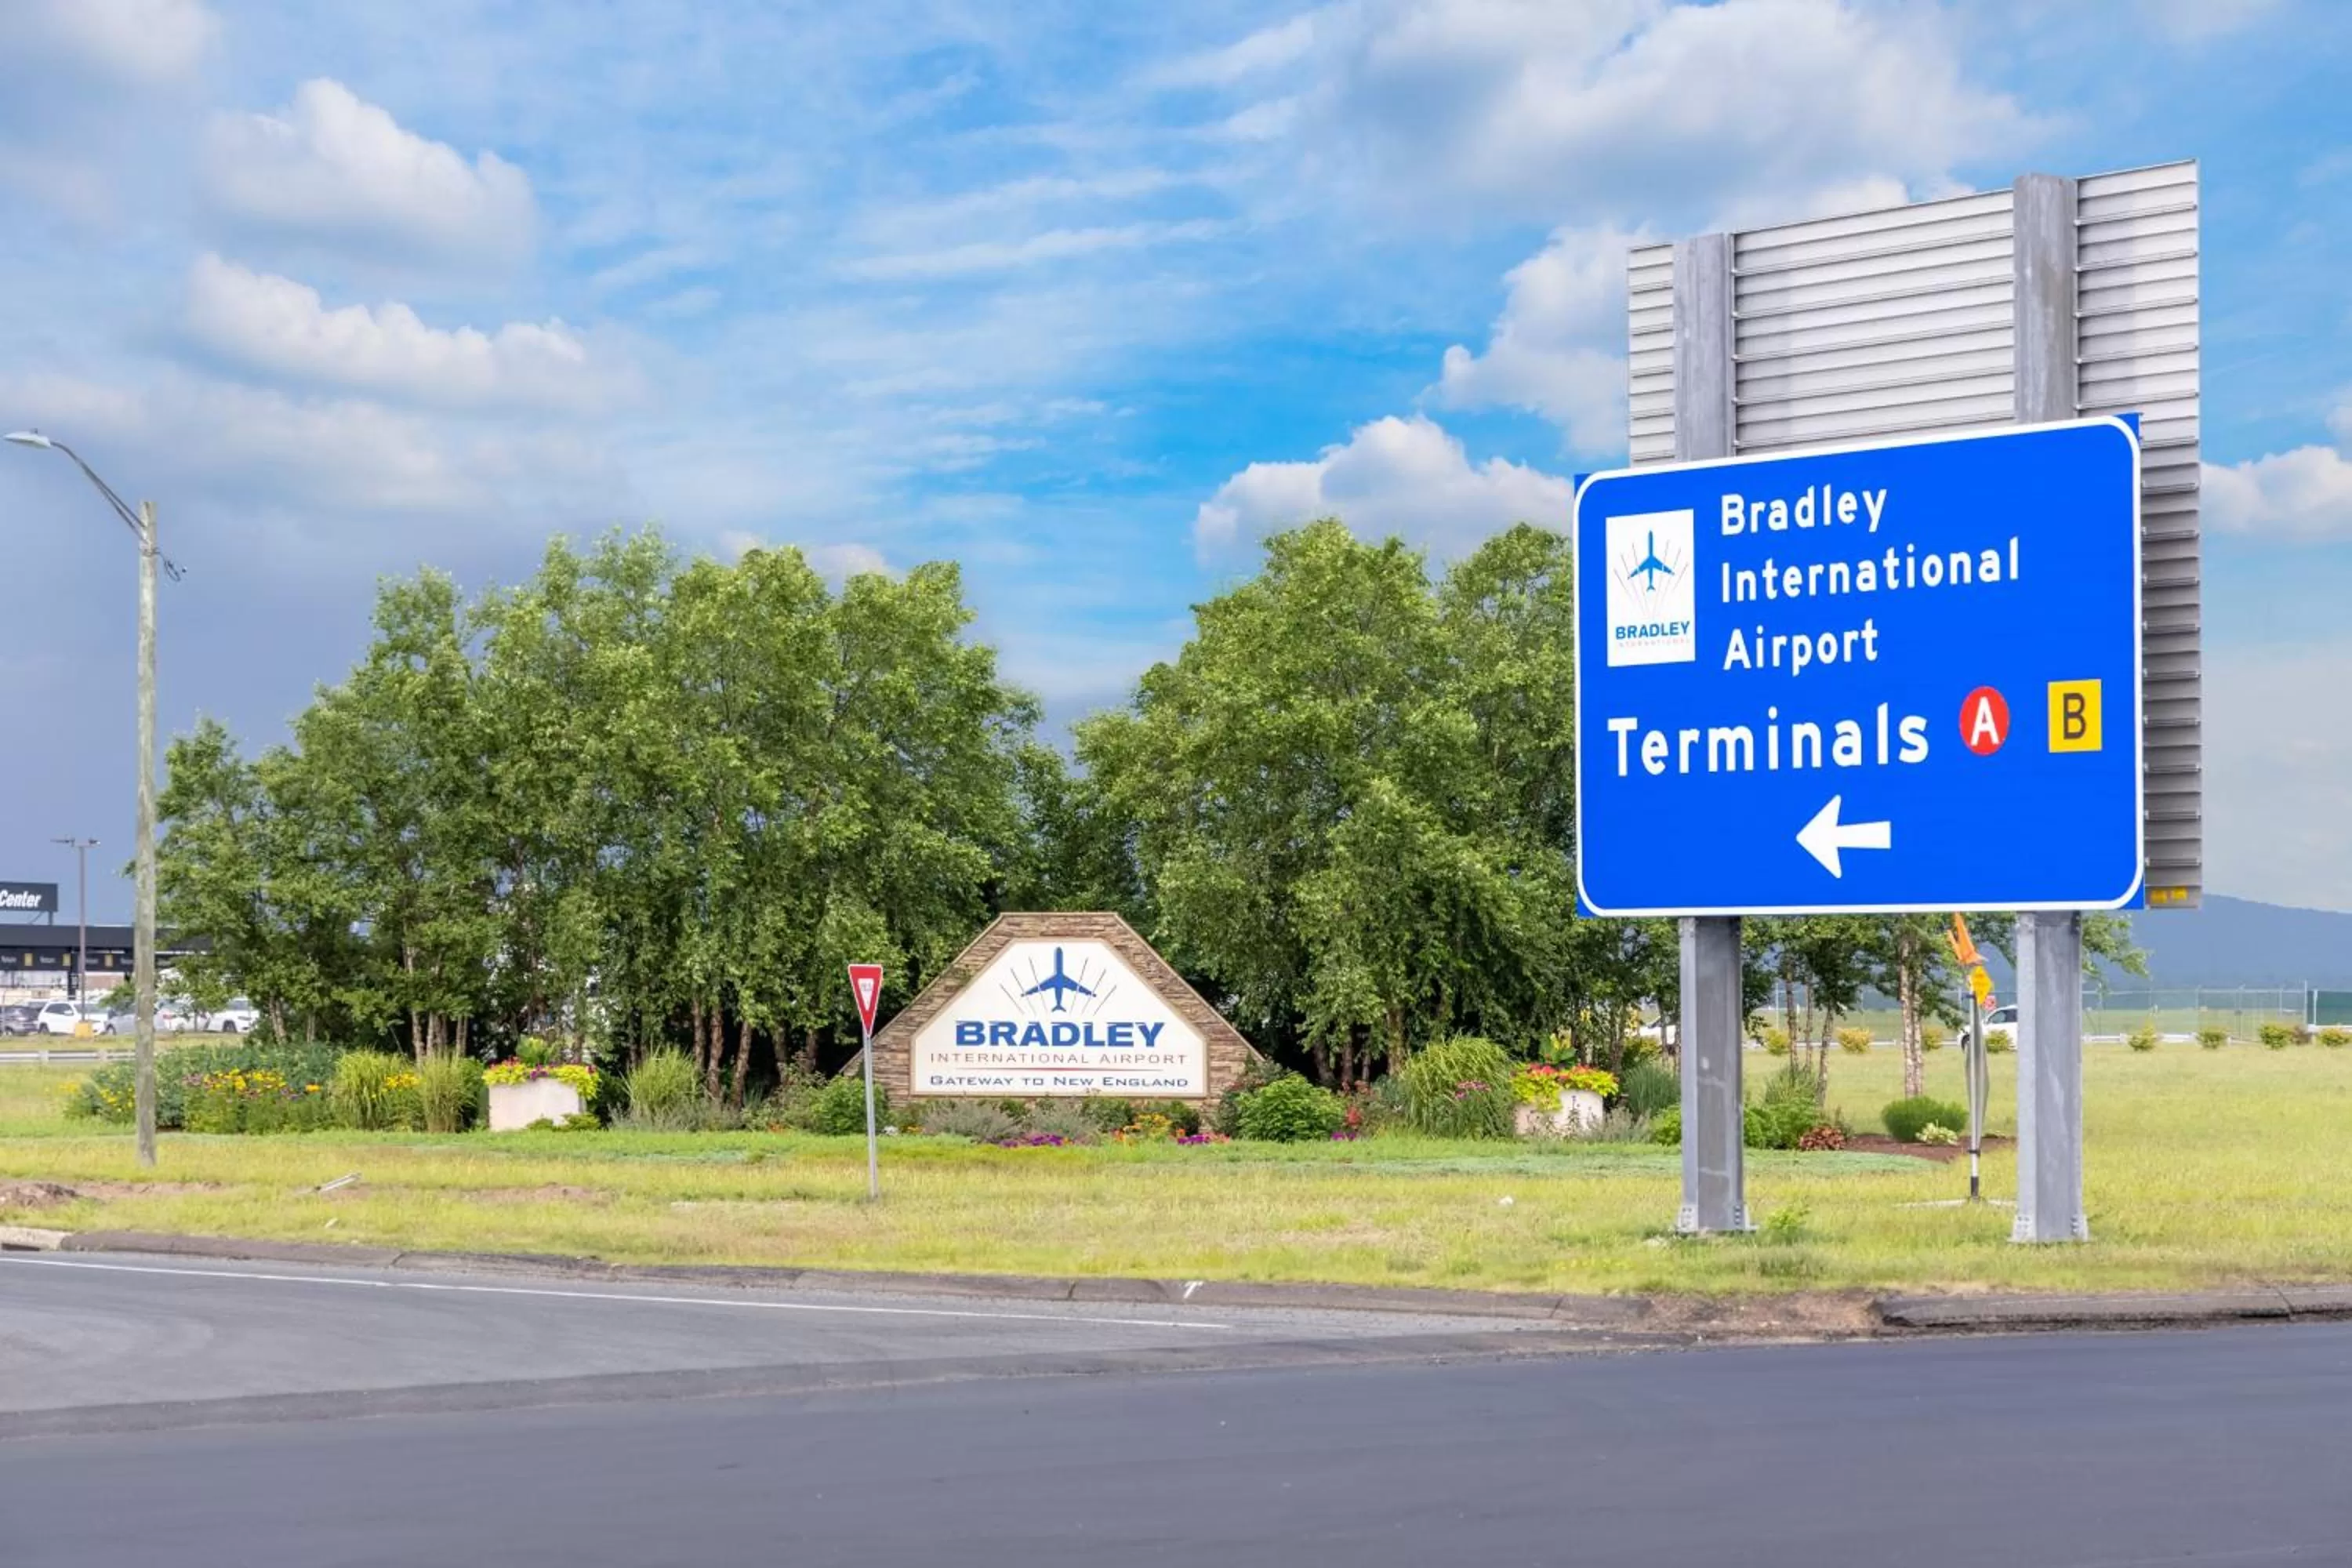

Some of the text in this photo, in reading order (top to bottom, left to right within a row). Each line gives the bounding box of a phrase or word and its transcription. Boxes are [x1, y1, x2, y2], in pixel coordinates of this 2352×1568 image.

[1721, 484, 1887, 535] Bradley
[1722, 535, 2020, 603] International
[1615, 620, 1690, 640] BRADLEY
[1723, 619, 1878, 676] Airport
[1607, 692, 2088, 776] Terminals A B
[0, 889, 42, 907] Center
[956, 1020, 1165, 1047] BRADLEY
[931, 1053, 1188, 1065] INTERNATIONAL AIRPORT
[931, 1076, 1013, 1086] GATEWAY
[1053, 1076, 1094, 1087] NEW
[1102, 1076, 1189, 1087] ENGLAND
